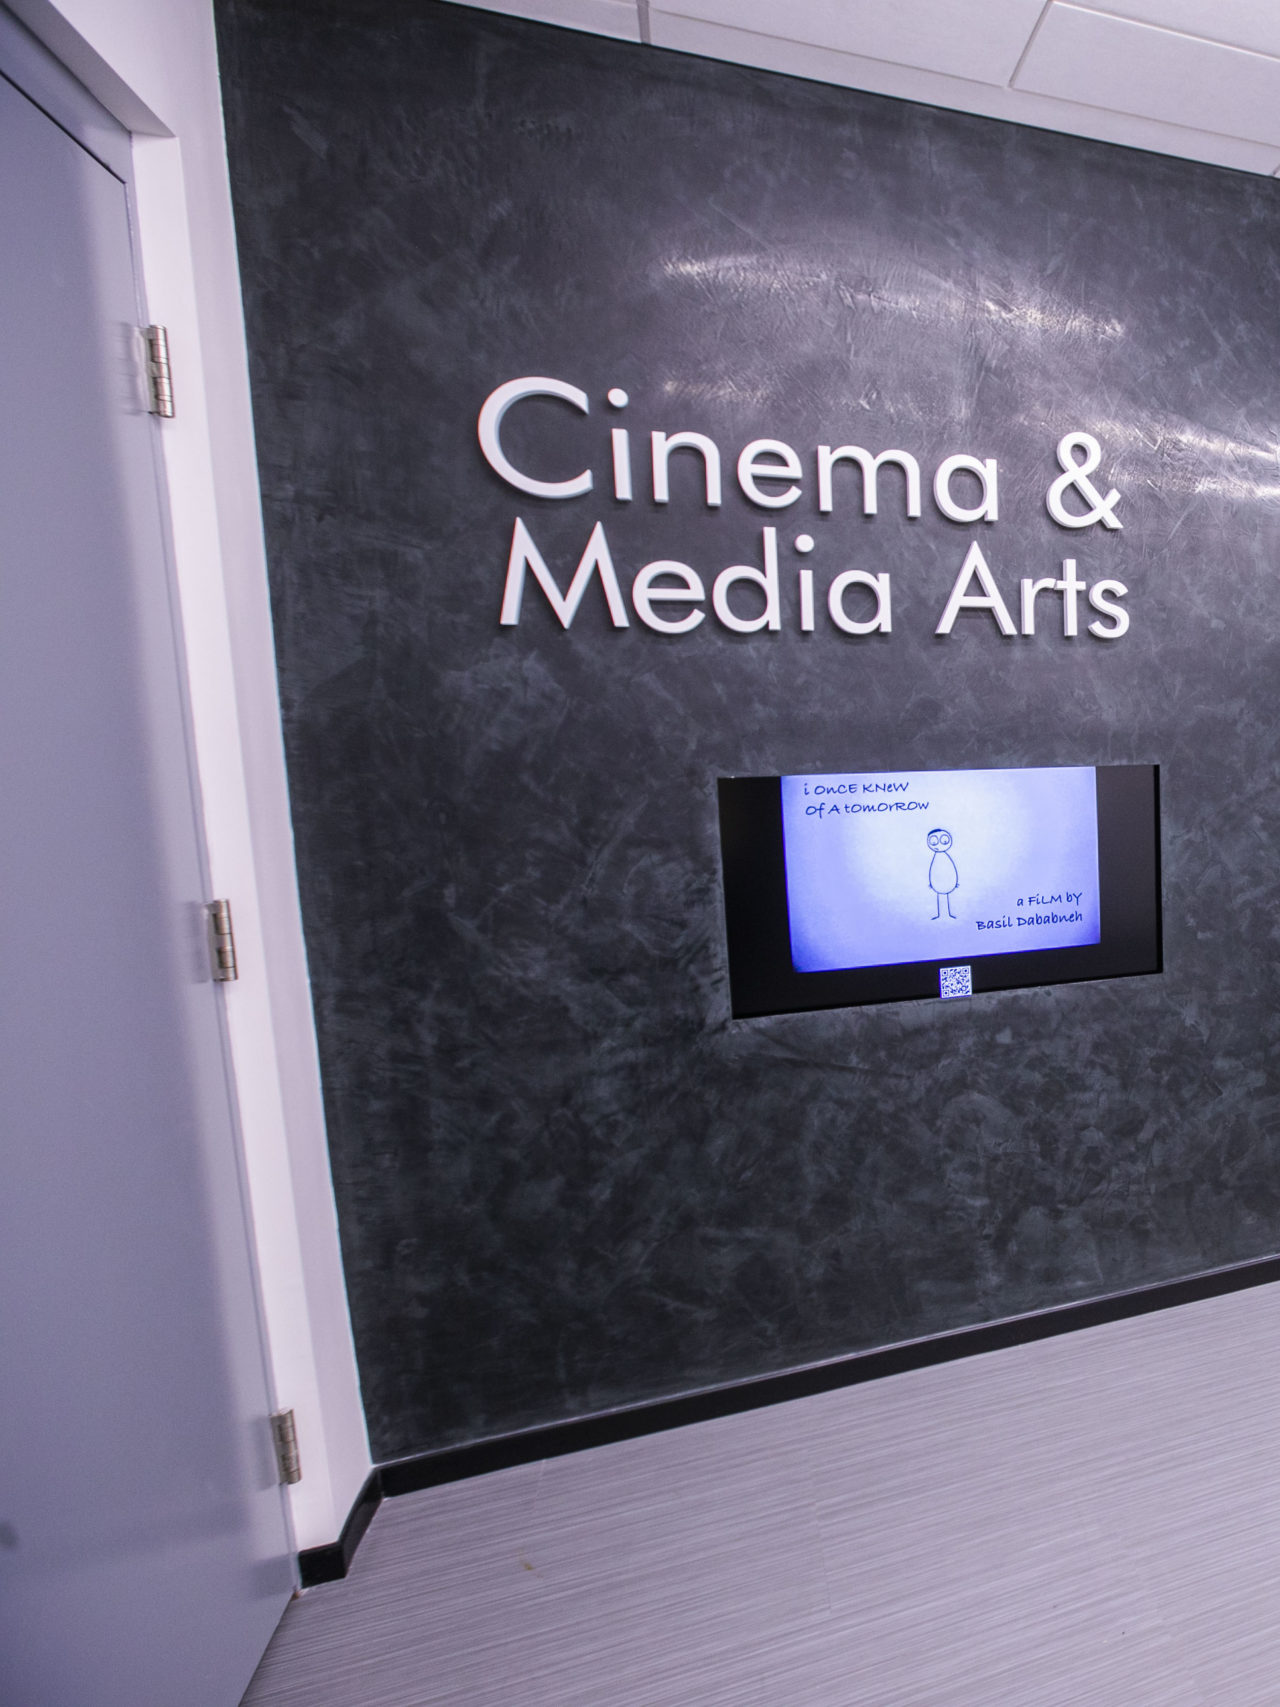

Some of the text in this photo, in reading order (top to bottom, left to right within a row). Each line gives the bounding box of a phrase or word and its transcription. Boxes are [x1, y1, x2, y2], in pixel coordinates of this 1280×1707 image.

[478, 376, 1123, 529] Cinema &
[500, 516, 1130, 638] Media Arts
[828, 804, 840, 814] A
[1016, 898, 1024, 906] a
[976, 911, 1083, 931] Basil Dababneh
